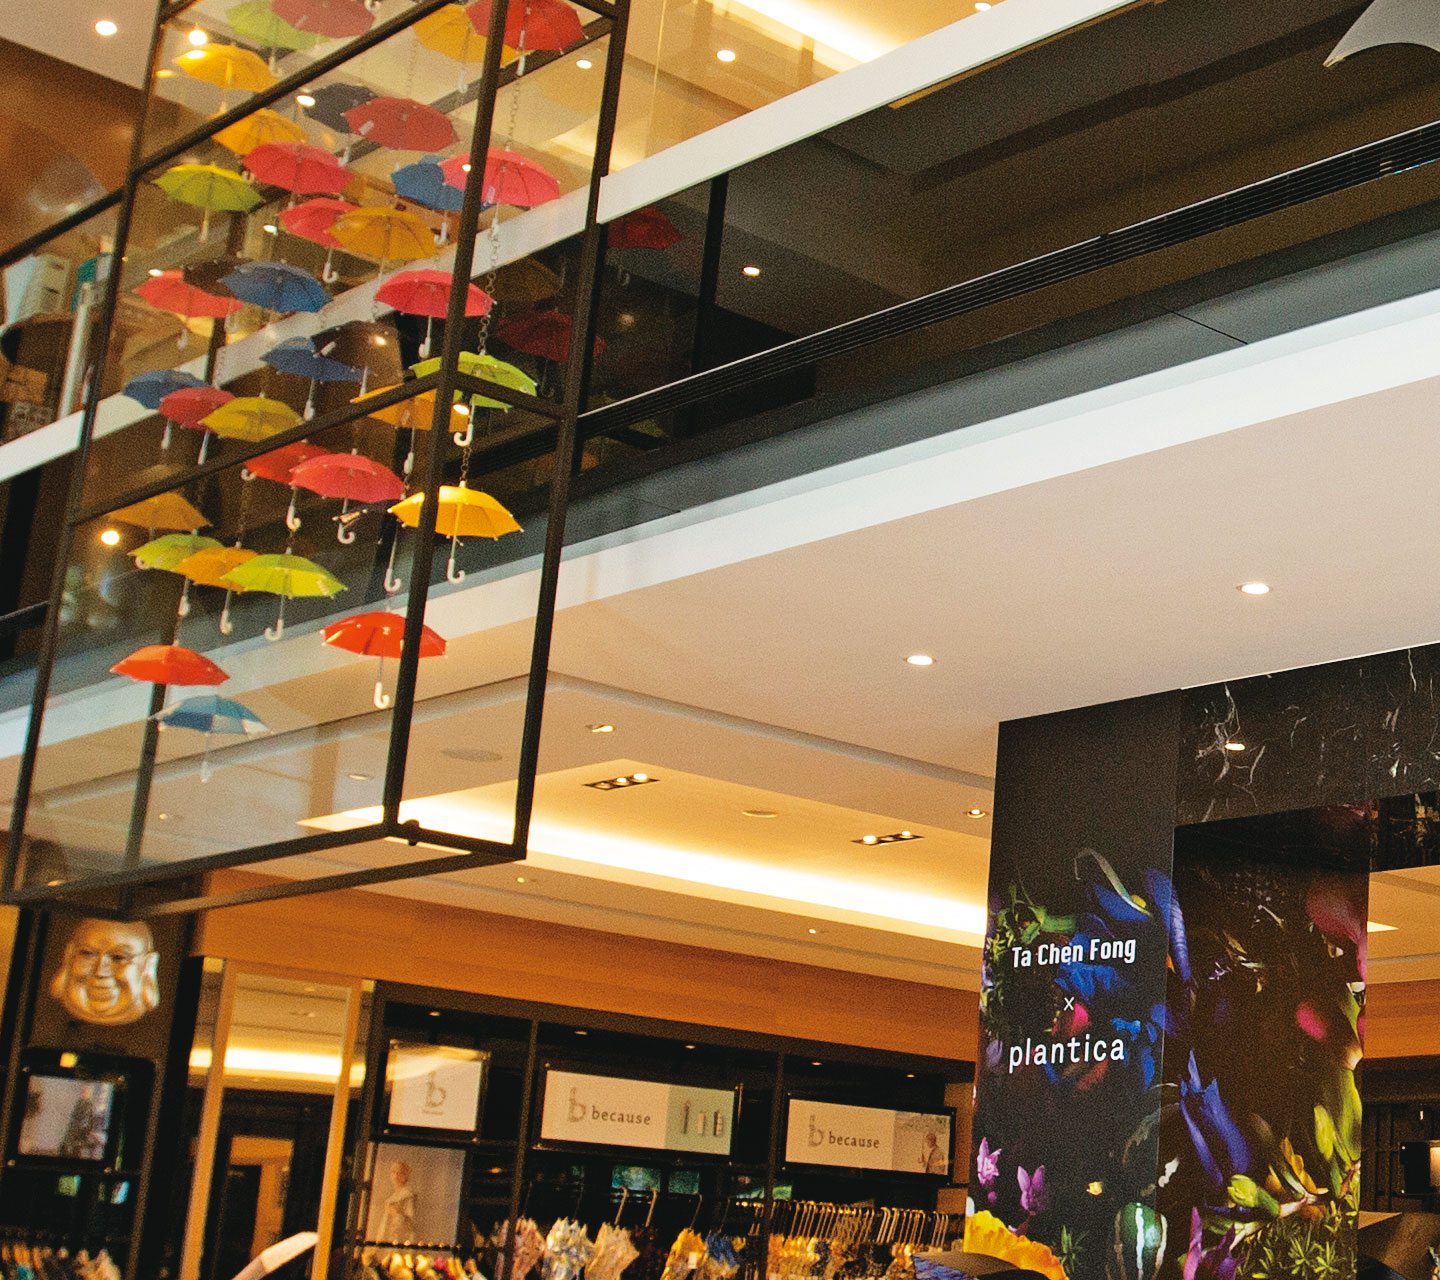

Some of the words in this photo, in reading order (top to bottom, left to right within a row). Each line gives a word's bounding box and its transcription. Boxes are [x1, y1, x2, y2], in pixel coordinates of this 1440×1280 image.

[1012, 946, 1032, 968] Ta
[1037, 943, 1084, 965] Chen
[1090, 938, 1137, 964] Fong
[1009, 1033, 1125, 1074] plantica
[591, 1105, 652, 1126] because
[828, 1130, 881, 1149] because
